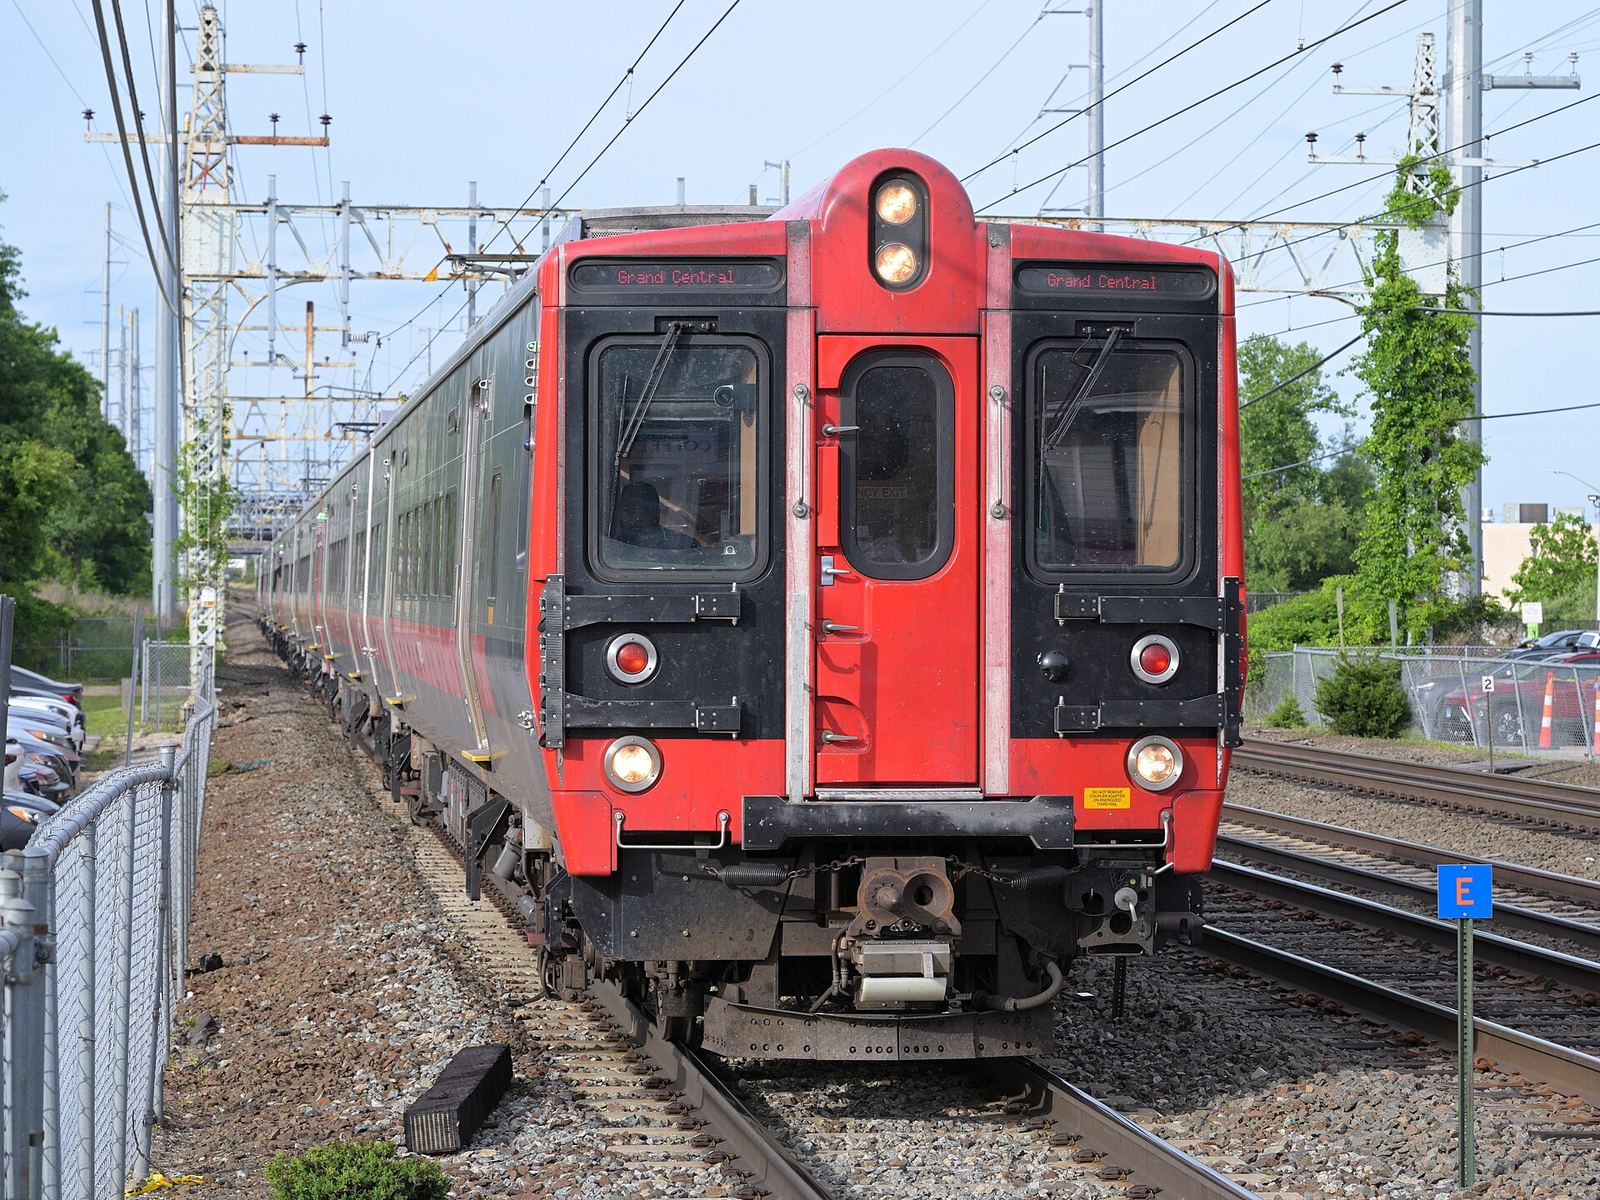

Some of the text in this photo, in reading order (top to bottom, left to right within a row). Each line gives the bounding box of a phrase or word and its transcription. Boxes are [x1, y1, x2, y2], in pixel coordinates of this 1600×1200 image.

[618, 269, 734, 284] Grand Central
[1047, 273, 1157, 290] Grand Central
[882, 487, 906, 498] EXIT
[1485, 678, 1492, 689] 2
[1456, 877, 1474, 905] E
